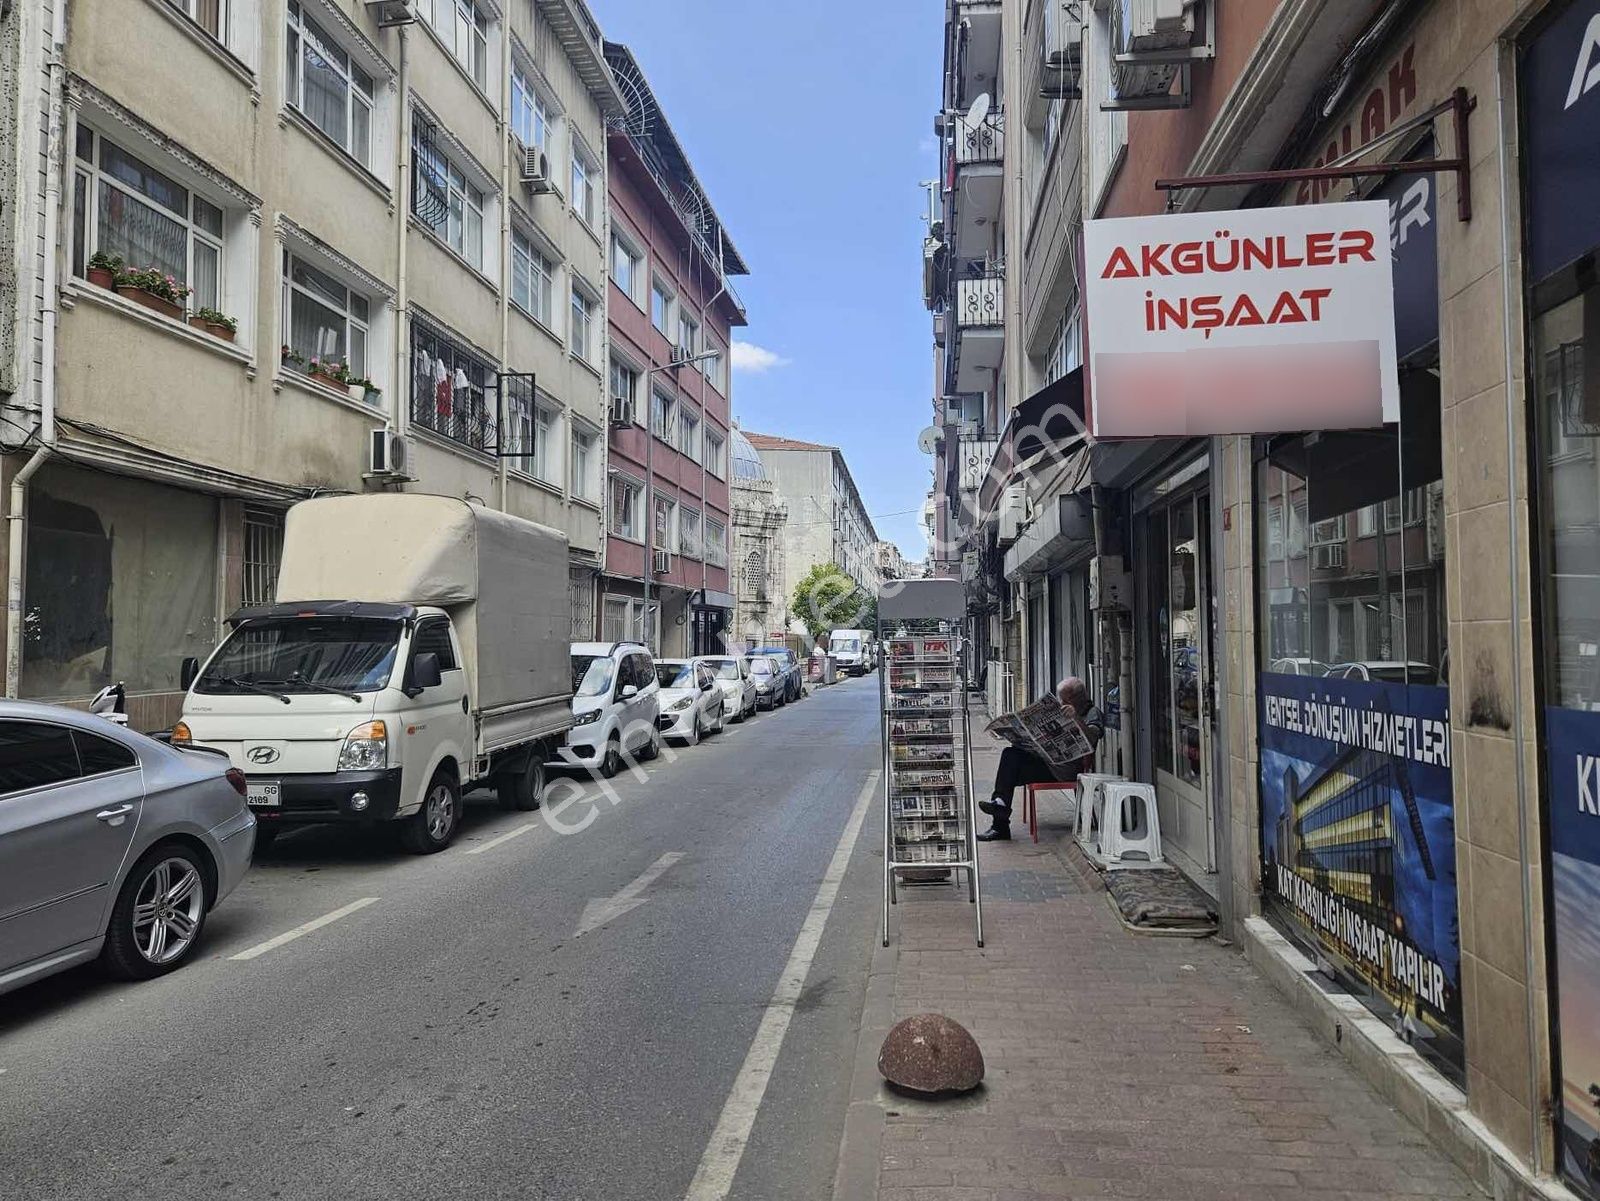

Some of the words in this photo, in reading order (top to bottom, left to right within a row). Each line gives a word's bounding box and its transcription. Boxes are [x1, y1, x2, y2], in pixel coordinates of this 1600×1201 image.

[1100, 230, 1376, 279] AKGÜNLER
[1145, 290, 1332, 340] İNŞAAT
[1265, 695, 1303, 733] KENTSEL
[1304, 693, 1360, 755] DÖNÜŞÜM
[1362, 700, 1450, 768] HİZMETLERİ
[1277, 864, 1293, 902] KAT
[1295, 876, 1340, 938] KARŞILIĞI
[1342, 898, 1386, 968] İNŞAAT
[1388, 934, 1446, 1013] YAPILIR
